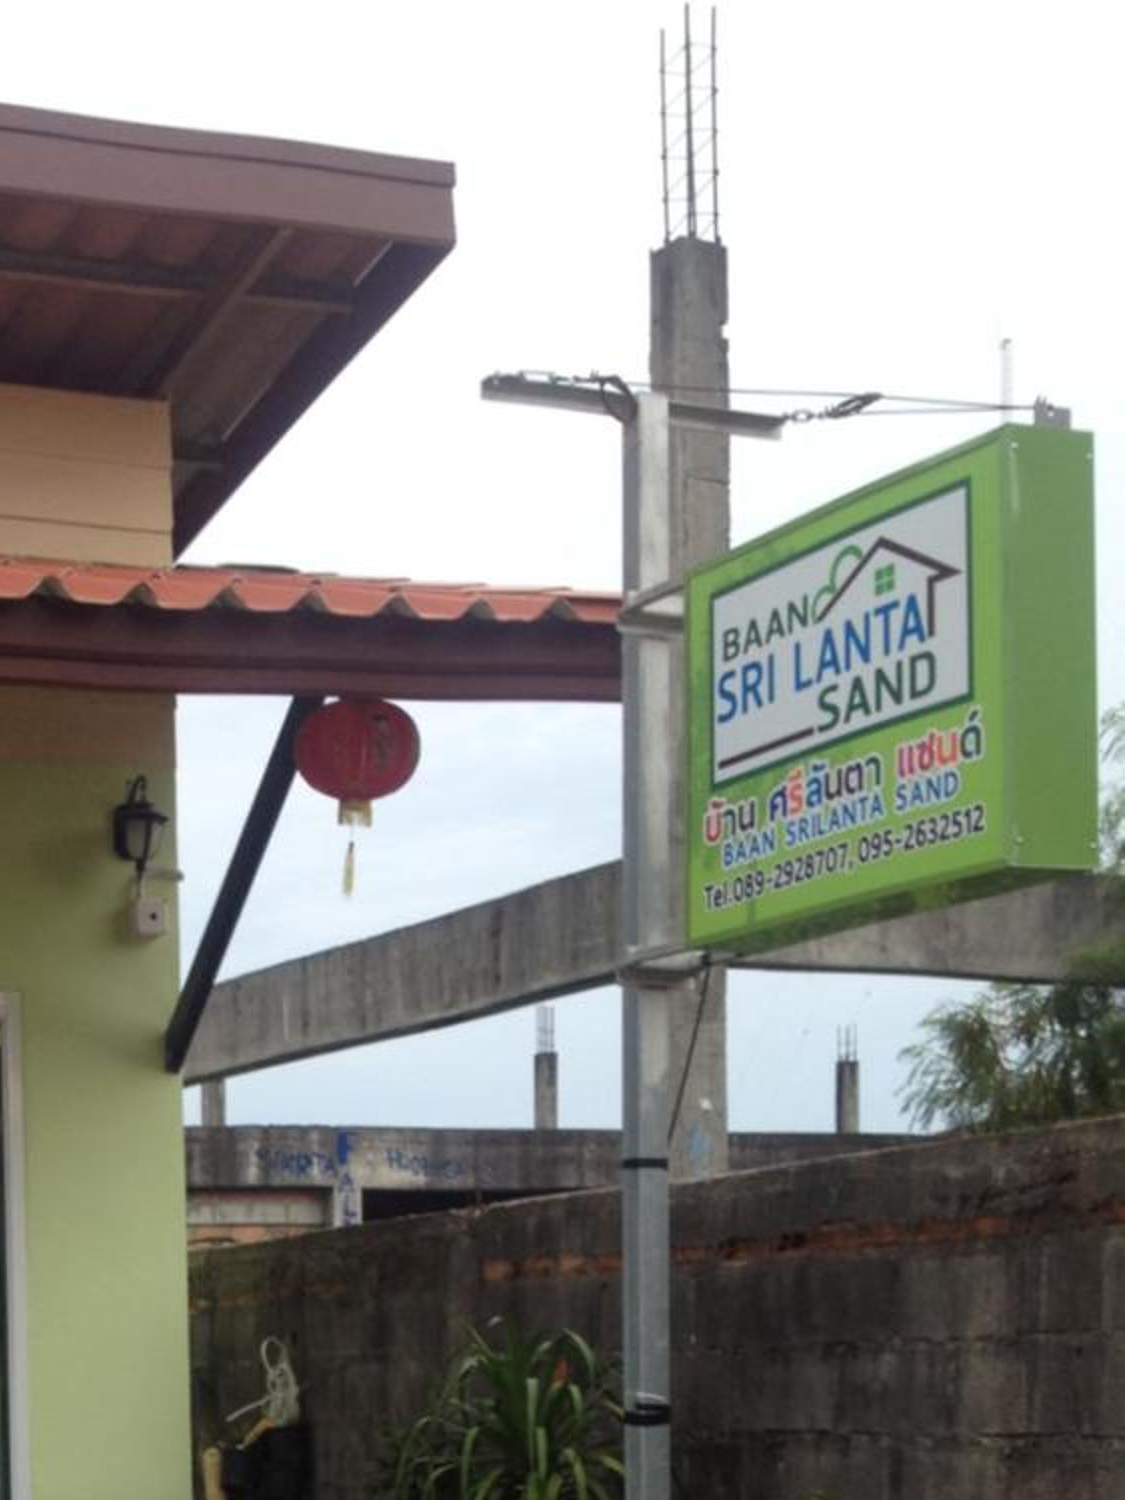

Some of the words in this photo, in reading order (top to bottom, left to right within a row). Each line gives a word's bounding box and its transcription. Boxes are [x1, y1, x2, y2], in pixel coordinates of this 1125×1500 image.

[716, 652, 775, 725] SRI
[793, 592, 927, 693] LANTA
[722, 594, 810, 663] BAAN
[816, 650, 937, 733] SAND
[722, 830, 776, 867] BAAN
[785, 793, 885, 847] SRILANTA
[895, 770, 960, 811] SAND
[858, 803, 986, 866] 095-2632512
